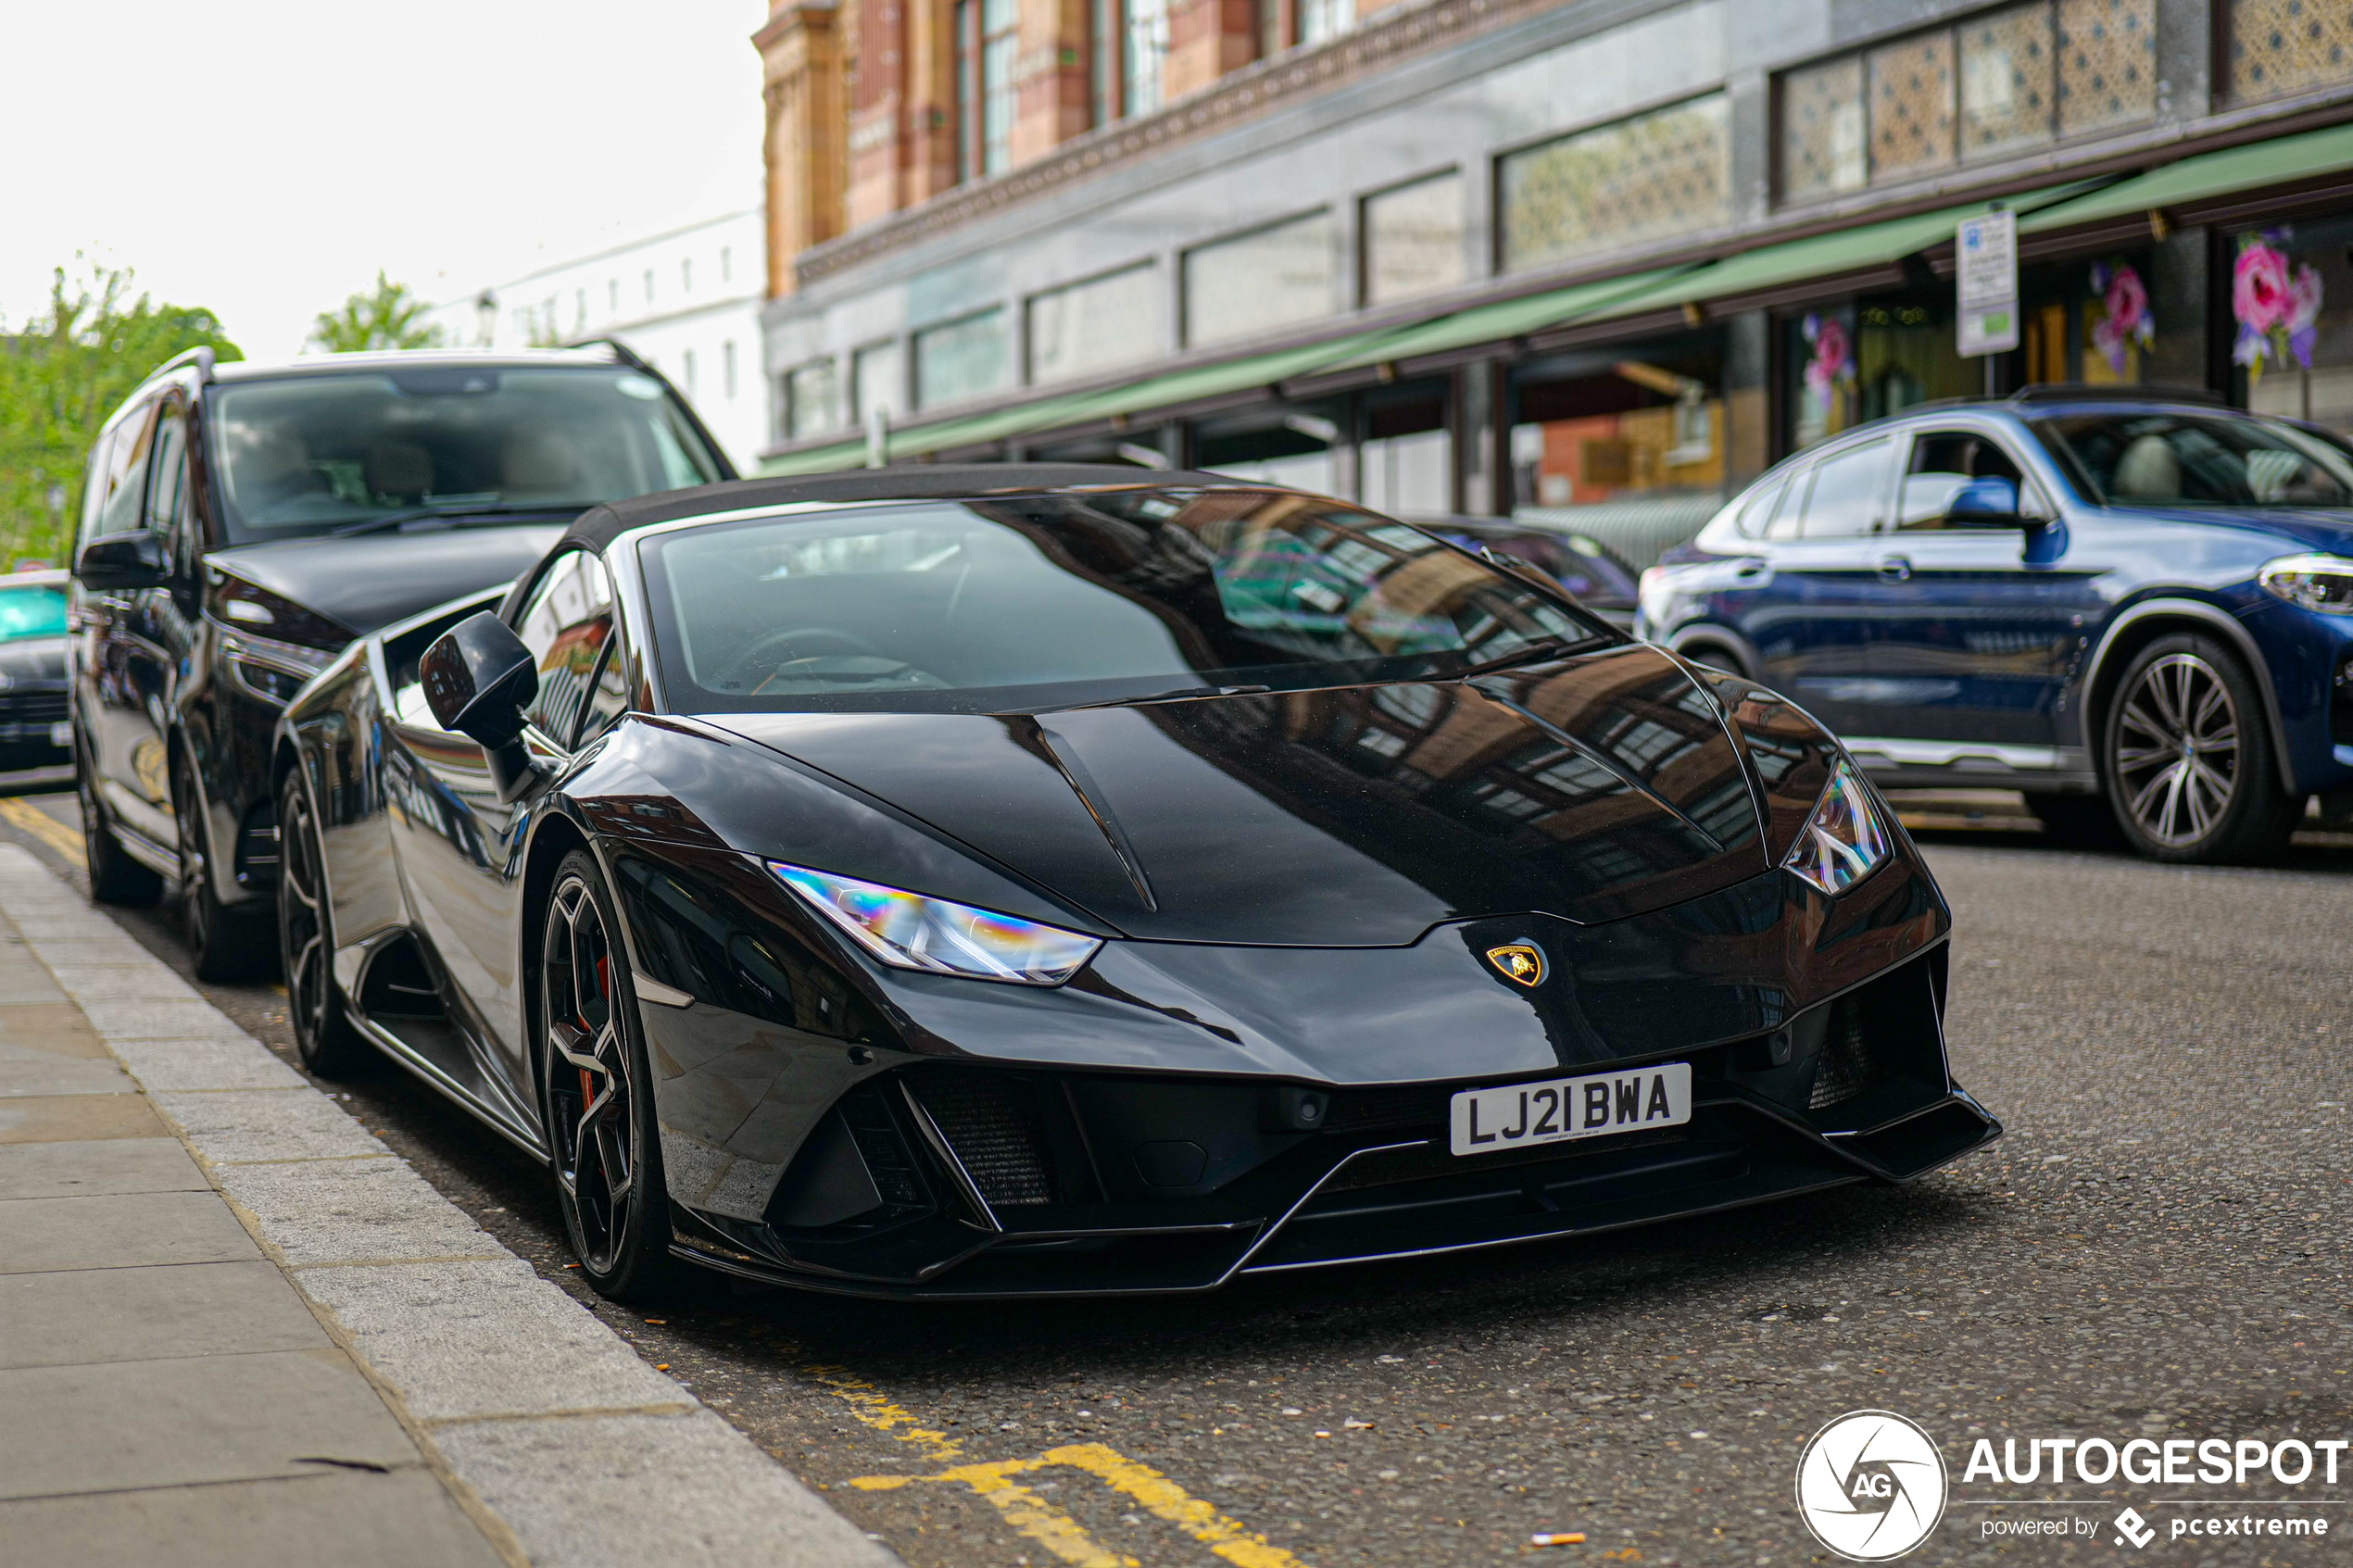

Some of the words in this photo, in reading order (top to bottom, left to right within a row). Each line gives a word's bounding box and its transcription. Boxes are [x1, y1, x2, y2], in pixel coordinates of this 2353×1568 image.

[1491, 947, 1532, 958] LAMBORGHINI
[1469, 1085, 1572, 1146] LJ21
[1583, 1073, 1671, 1130] BWA
